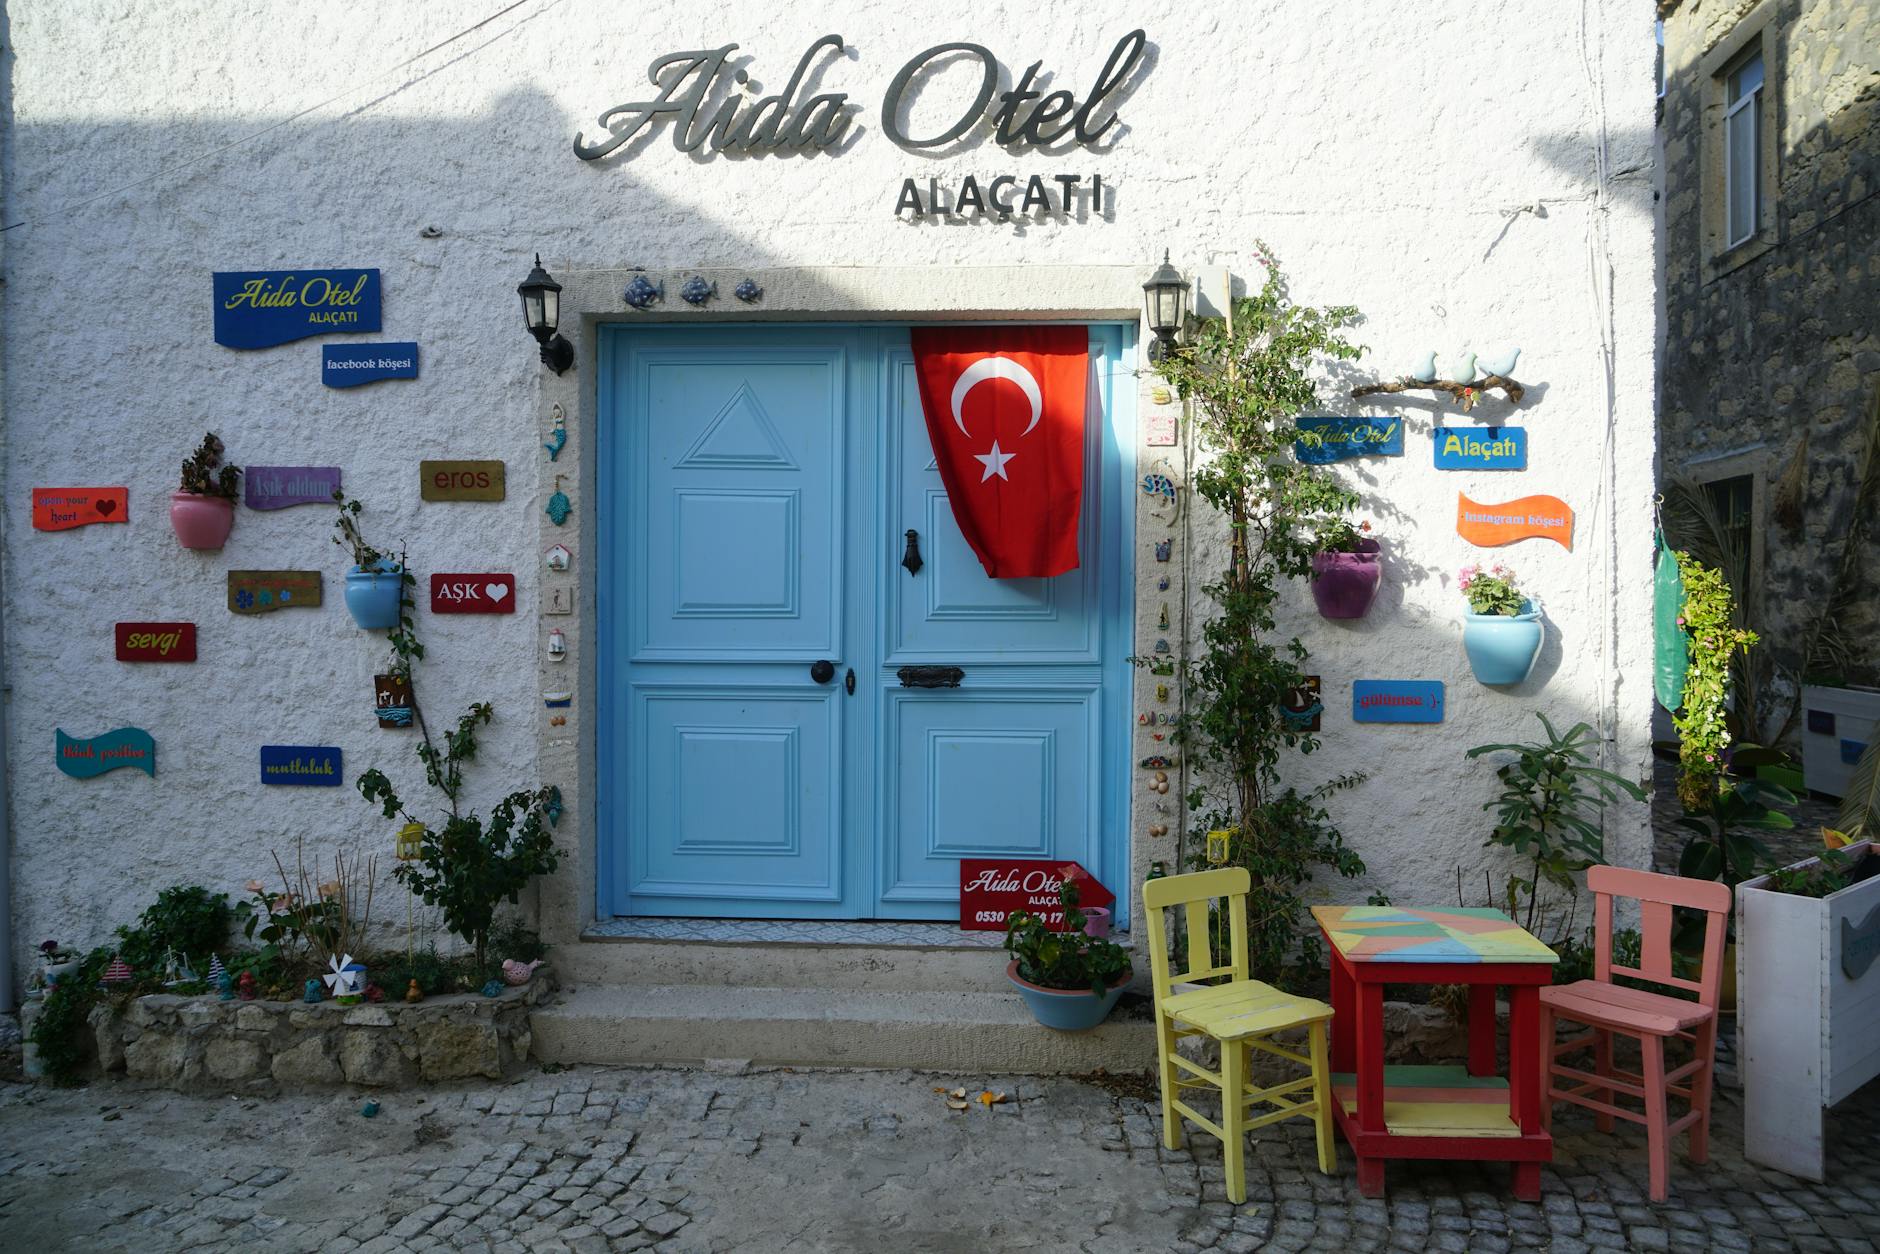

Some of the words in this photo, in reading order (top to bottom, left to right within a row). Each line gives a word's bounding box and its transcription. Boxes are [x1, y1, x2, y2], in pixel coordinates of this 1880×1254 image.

[573, 34, 849, 161] Aida
[881, 28, 1146, 149] Otel
[894, 173, 1102, 219] ALAÇATI
[224, 275, 298, 310] Aida
[301, 274, 368, 307] Otel
[309, 311, 358, 326] ALAÇATI
[327, 359, 376, 370] facebook
[378, 358, 412, 371] köşesi
[1351, 422, 1397, 444] Otel
[1442, 434, 1517, 461] Alaçatı
[287, 475, 331, 497] oldum
[434, 471, 490, 489] eros
[66, 496, 88, 508] your
[51, 508, 77, 524] heart
[1465, 511, 1526, 526] Instagram
[1528, 514, 1564, 529] köşesi
[437, 583, 481, 603] AŞK
[126, 628, 183, 656] sevgi
[63, 744, 96, 758] think
[266, 758, 335, 776] mutluluk
[964, 868, 1021, 892] Aida
[1023, 870, 1066, 893] Ote
[1028, 895, 1063, 907] ALAÇA
[975, 911, 1005, 922] 0530
[1050, 912, 1064, 924] 17
